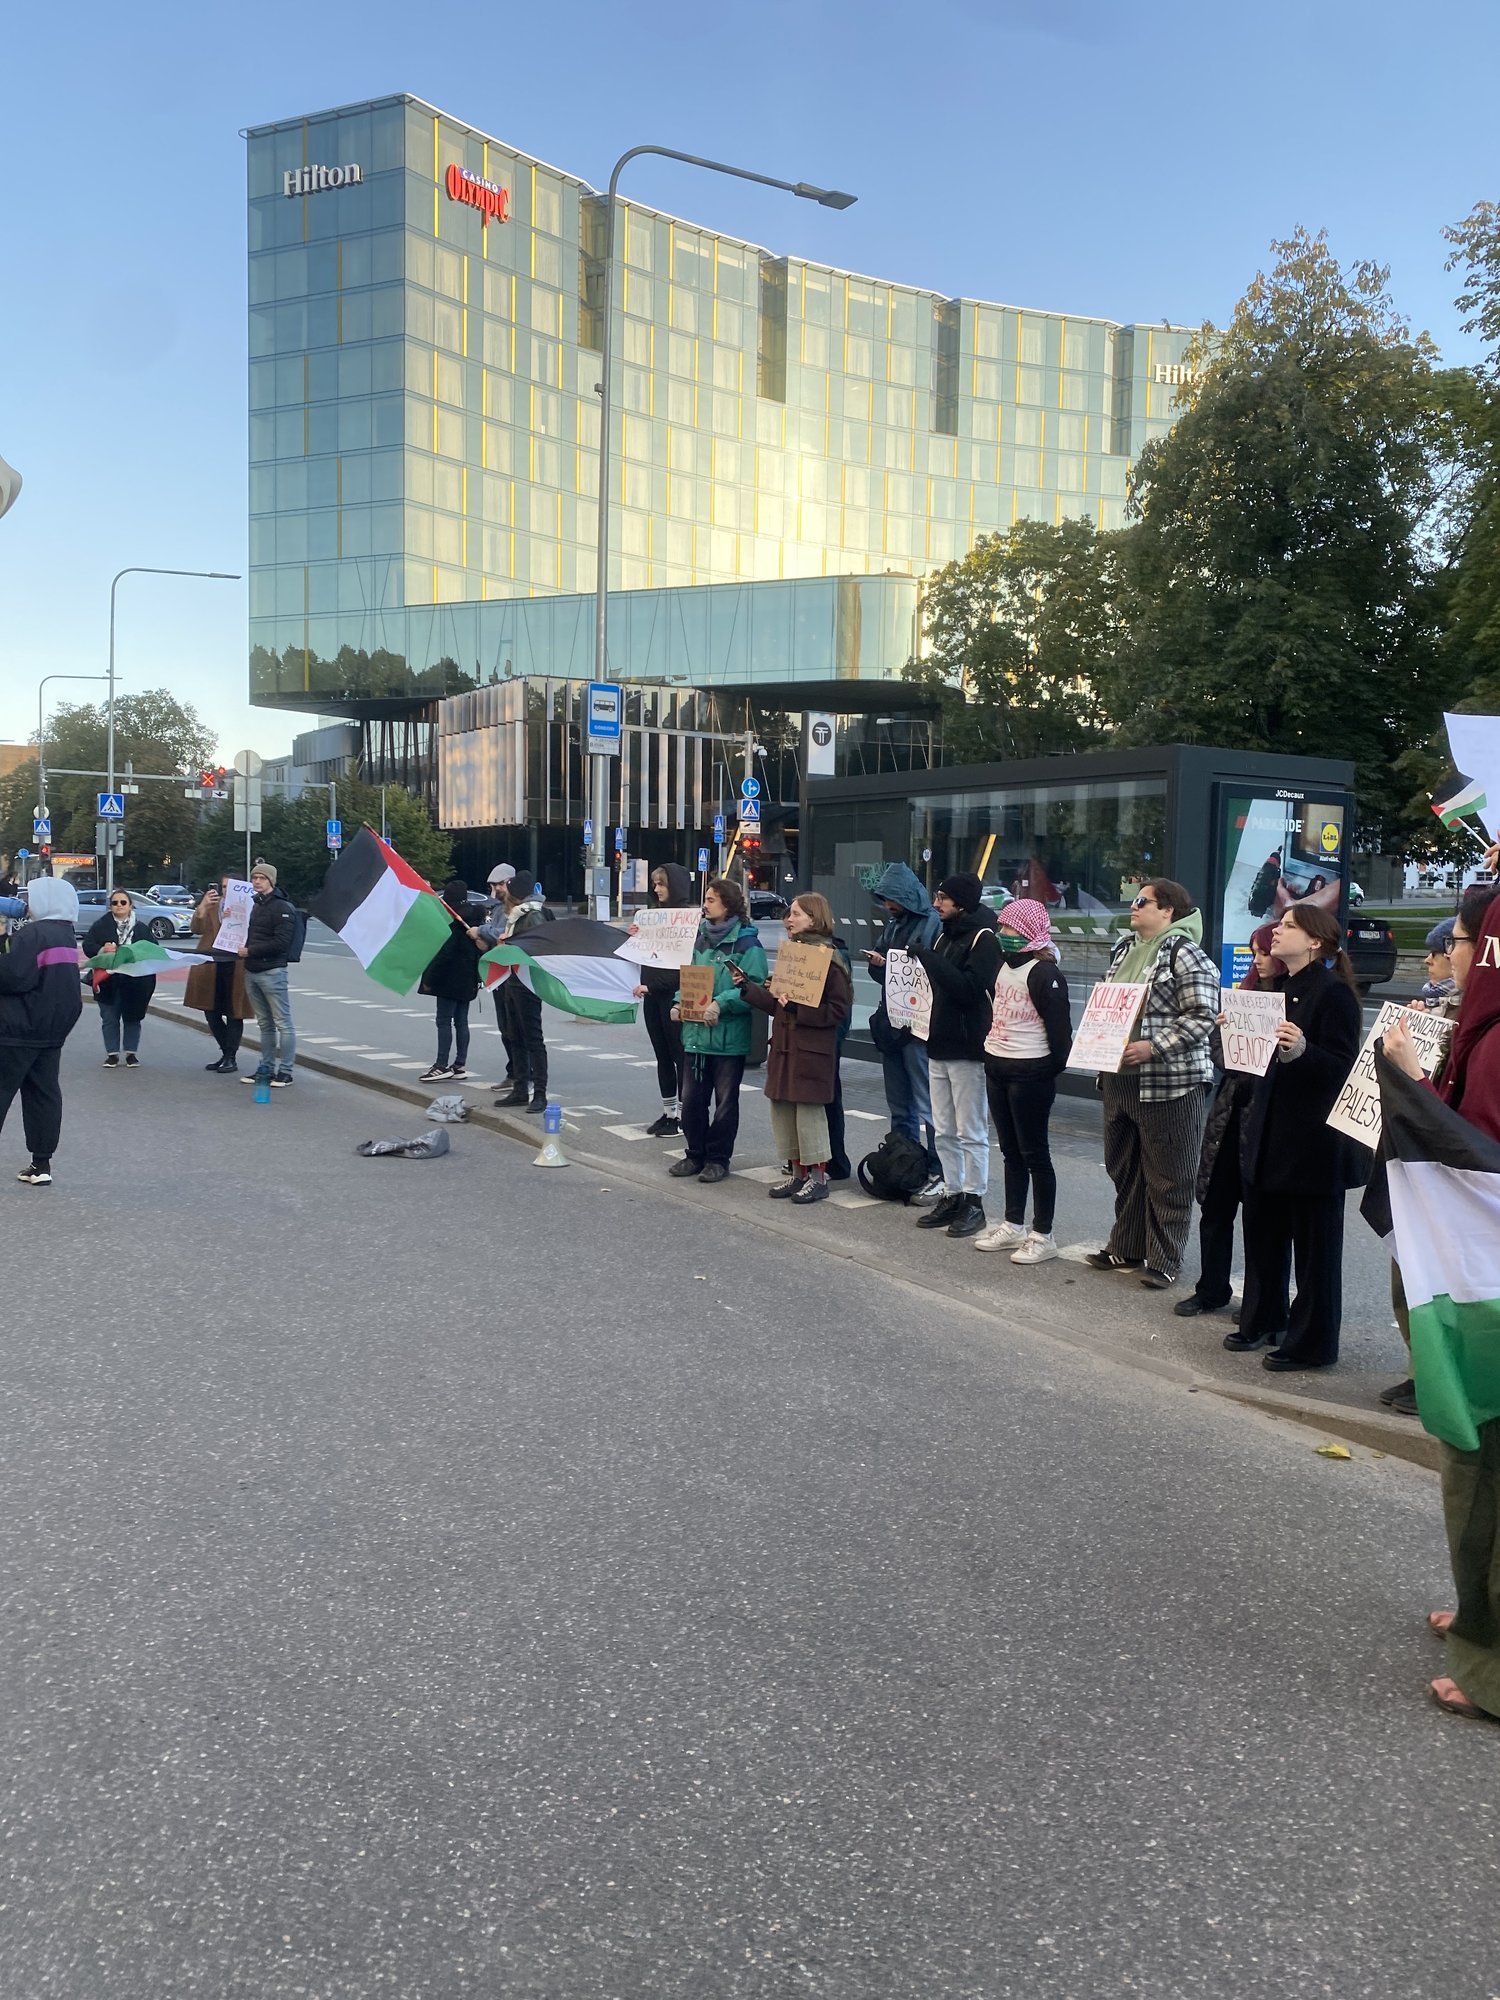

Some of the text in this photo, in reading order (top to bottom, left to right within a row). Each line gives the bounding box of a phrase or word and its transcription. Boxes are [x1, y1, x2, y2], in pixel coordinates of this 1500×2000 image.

[283, 163, 363, 198] Hilton
[462, 170, 499, 194] CASINO
[1154, 363, 1208, 385] Hilto
[1275, 790, 1305, 799] JCDecaux
[888, 975, 930, 993] AWAY
[1088, 986, 1138, 1010] KILLING
[1085, 1010, 1132, 1025] THE STORY
[1221, 1008, 1255, 1033] GAZAS
[1412, 1035, 1435, 1061] TOP!
